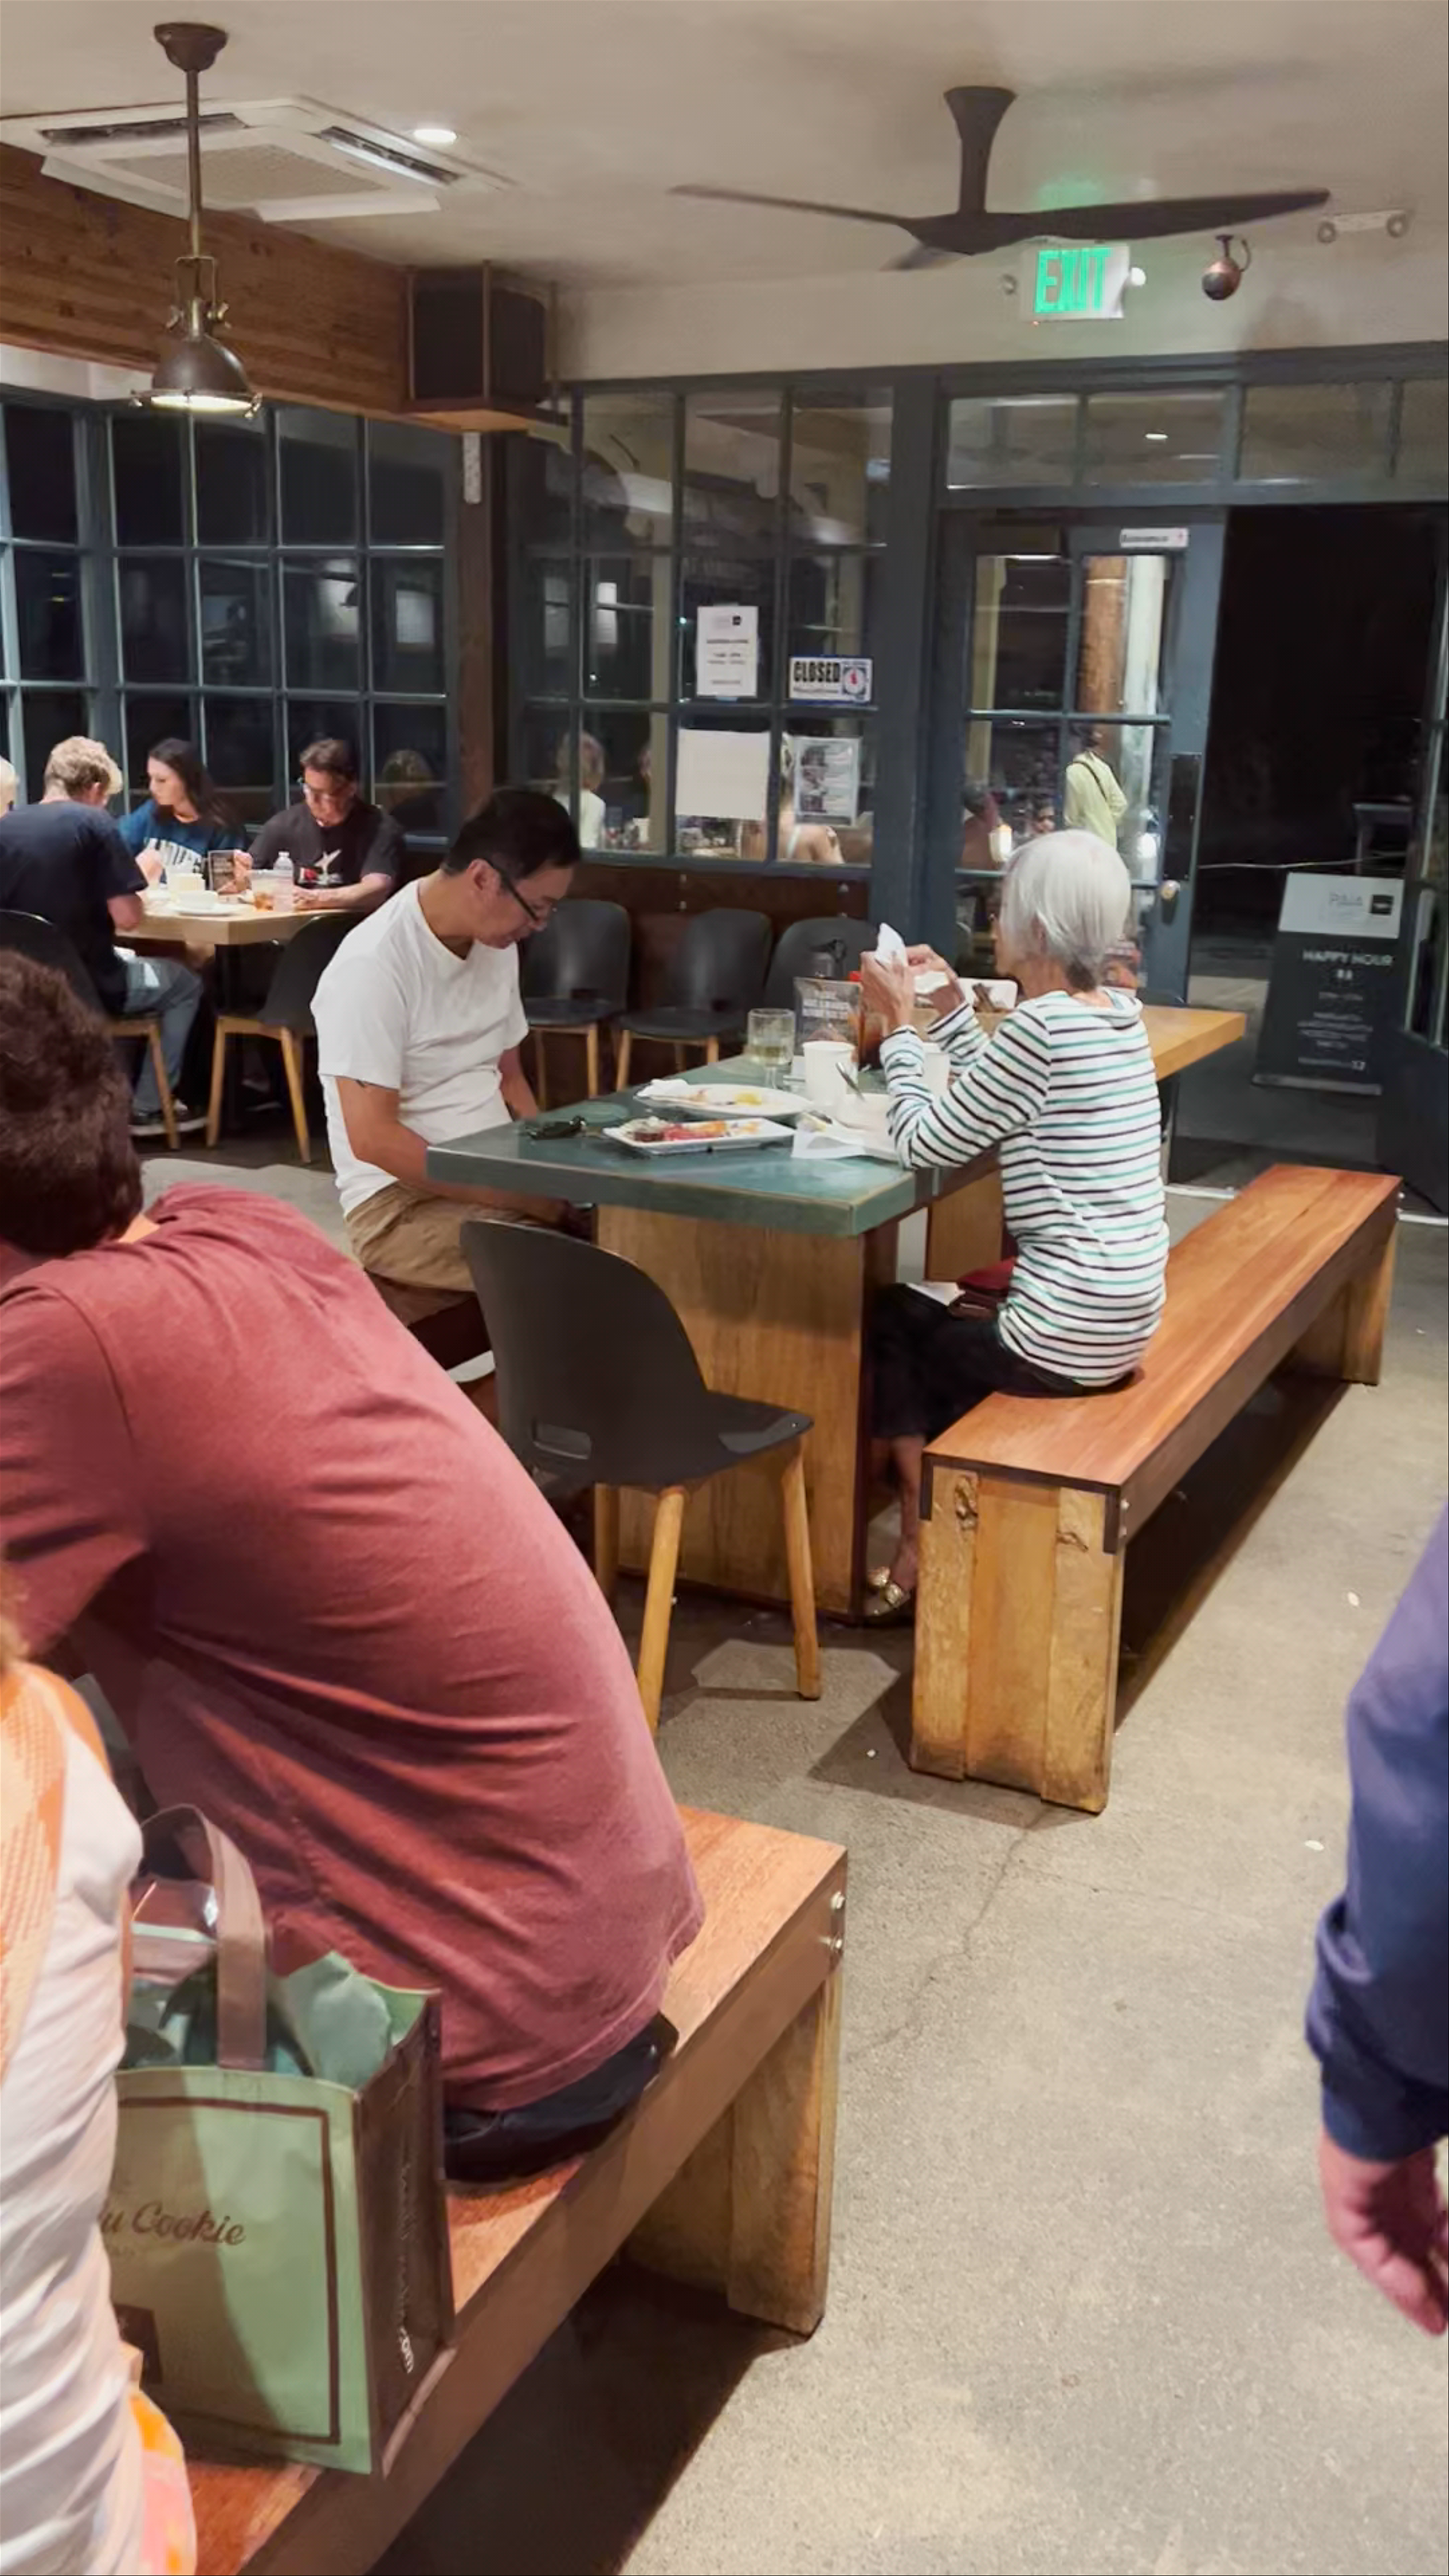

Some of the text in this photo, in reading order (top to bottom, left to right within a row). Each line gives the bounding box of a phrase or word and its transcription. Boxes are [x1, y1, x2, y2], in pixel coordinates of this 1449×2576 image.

[1035, 247, 1111, 313] EXIT
[794, 661, 840, 683] CLOSED
[1303, 950, 1392, 966] HAPPY HOUR
[132, 2201, 246, 2245] Cookie
